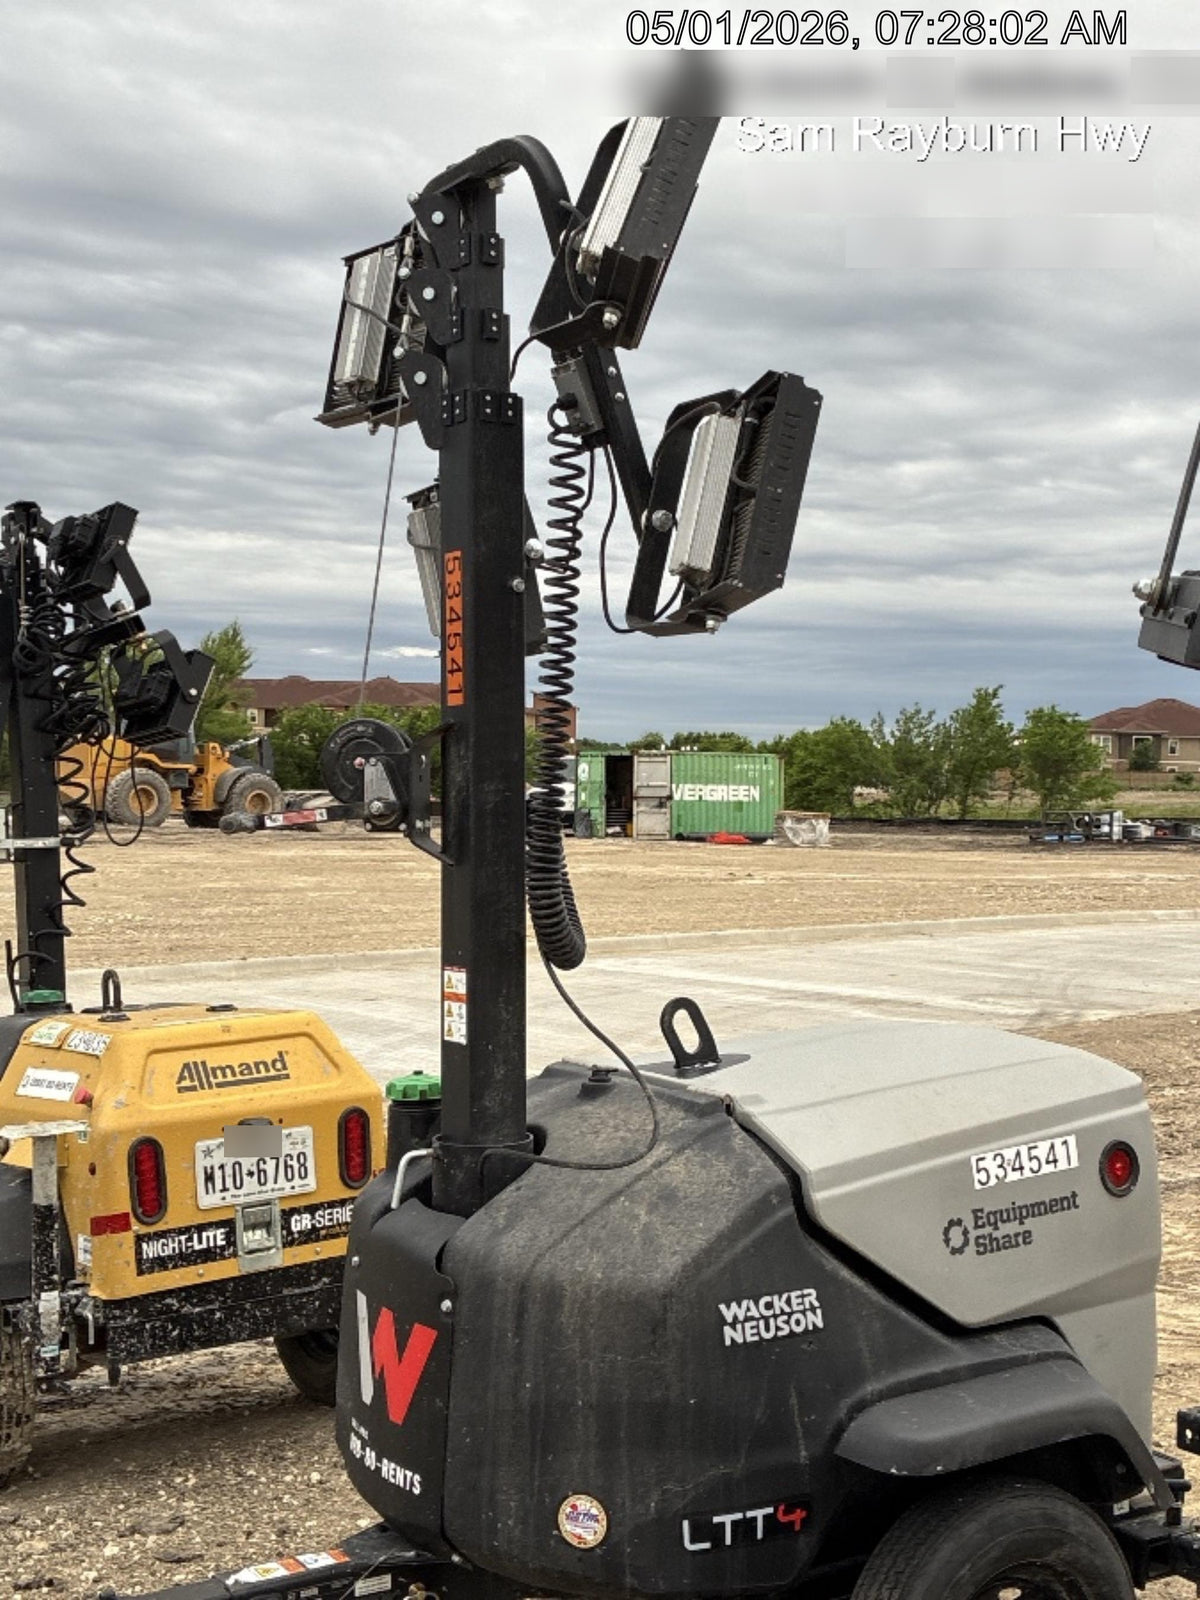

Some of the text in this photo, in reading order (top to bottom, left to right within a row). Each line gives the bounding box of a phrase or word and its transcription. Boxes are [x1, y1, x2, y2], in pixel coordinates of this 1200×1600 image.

[444, 551, 463, 695] 534541
[672, 783, 760, 801] VERGREEN
[176, 1050, 289, 1091] Allmand
[974, 1138, 1078, 1188] 534541
[971, 1190, 1080, 1230] Equipment
[141, 1228, 228, 1260] NIGHT-LITE
[290, 1204, 355, 1233] GR-SERIE
[973, 1227, 1034, 1257] Share
[717, 1288, 821, 1323] WACKER
[722, 1309, 824, 1347] NEUSON
[681, 1503, 808, 1551] LTT4
